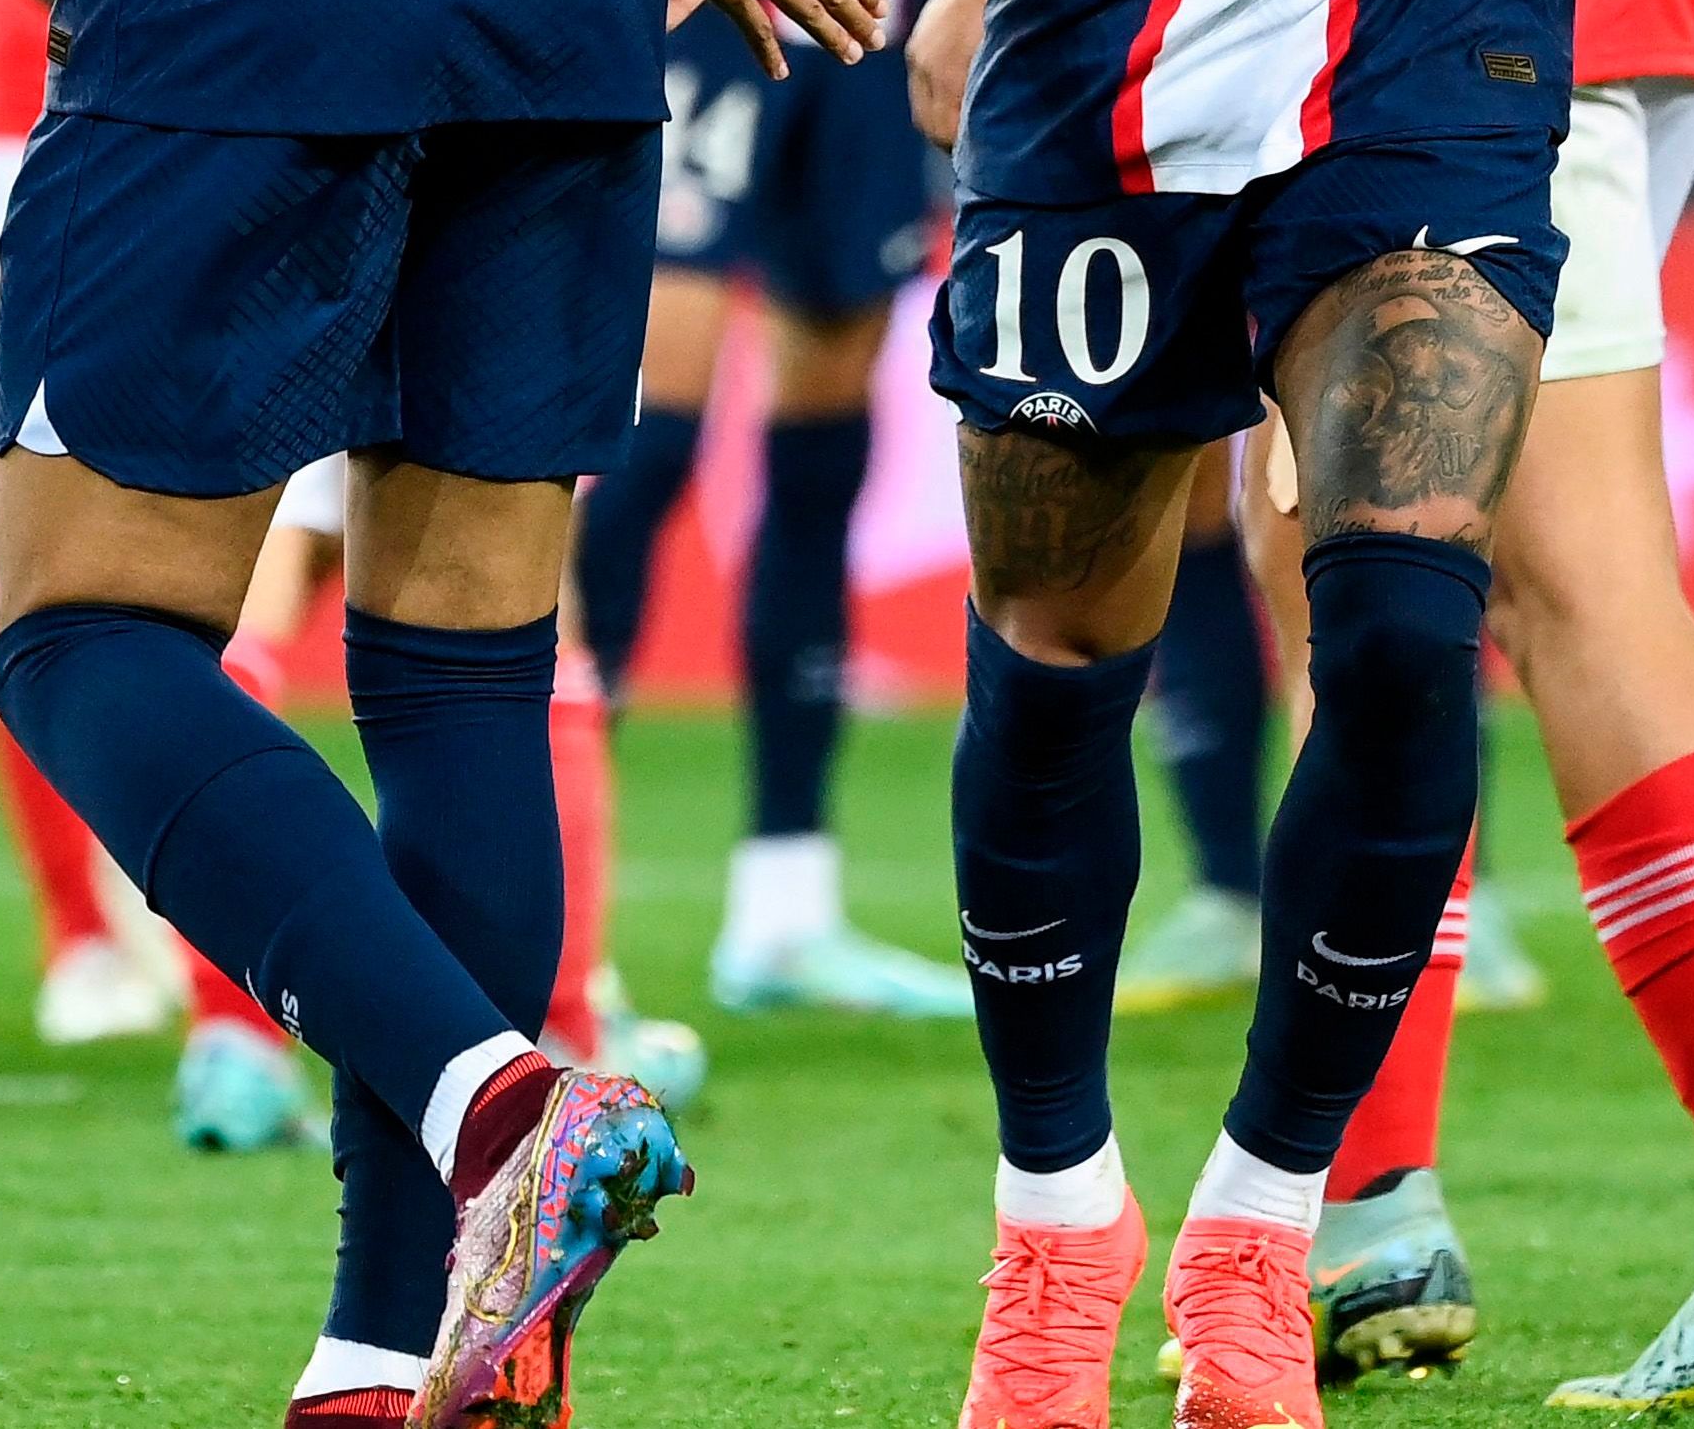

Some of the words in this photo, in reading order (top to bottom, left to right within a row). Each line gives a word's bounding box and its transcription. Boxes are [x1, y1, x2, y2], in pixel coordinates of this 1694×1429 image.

[979, 230, 1150, 385] 10
[1021, 397, 1081, 423] PARIS
[963, 939, 1083, 984] PARIS
[1297, 959, 1409, 1009] PARIS
